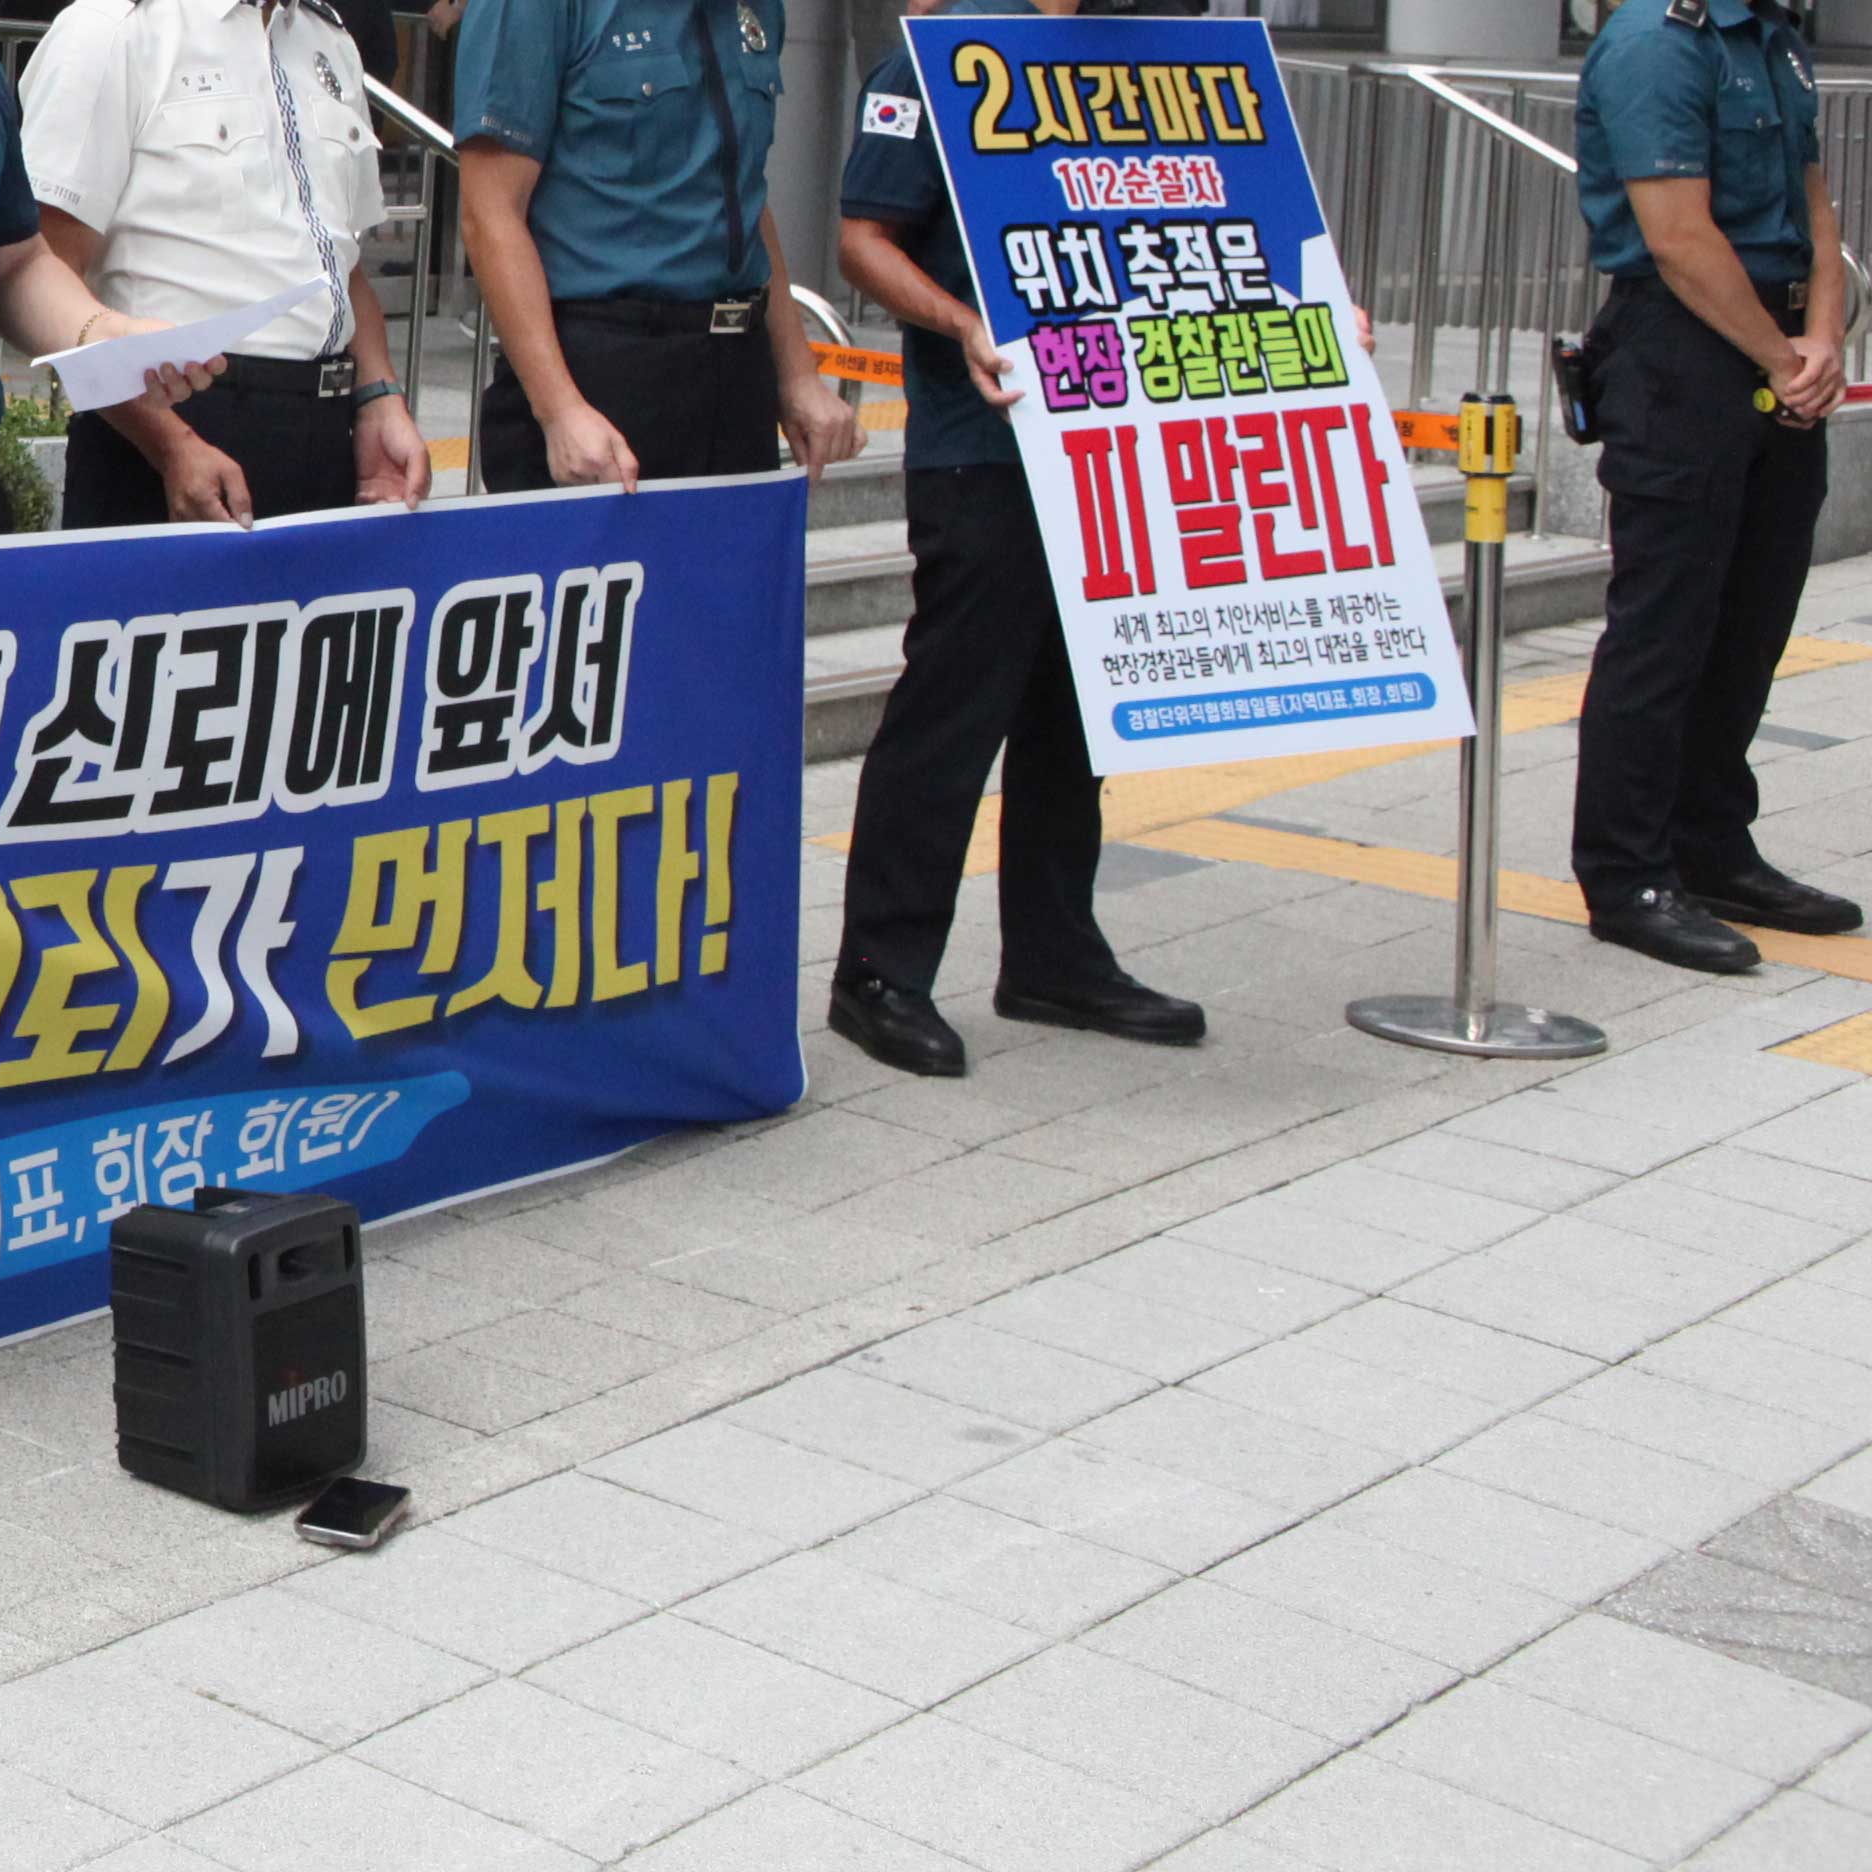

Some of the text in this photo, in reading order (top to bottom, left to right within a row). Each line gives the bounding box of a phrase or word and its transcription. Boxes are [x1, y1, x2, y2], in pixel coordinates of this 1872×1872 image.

[954, 42, 1266, 151] 2시간마다
[1055, 159, 1224, 208] 112순찰차
[1004, 223, 1276, 310] 위치 추적은
[1031, 305, 1349, 409] 현장 경찰관들의
[1065, 404, 1397, 601] 피 말린다
[1102, 626, 1428, 686] 현장경찰관들에게 최고의 대접을 원한다
[1114, 592, 1402, 646] 세계 최고의 치안서비스를 제공하는
[8, 606, 401, 825] 신뢰에
[427, 579, 634, 774] 앞서
[327, 772, 741, 1039] 먼저다!
[268, 1369, 348, 1428] MIPRO
